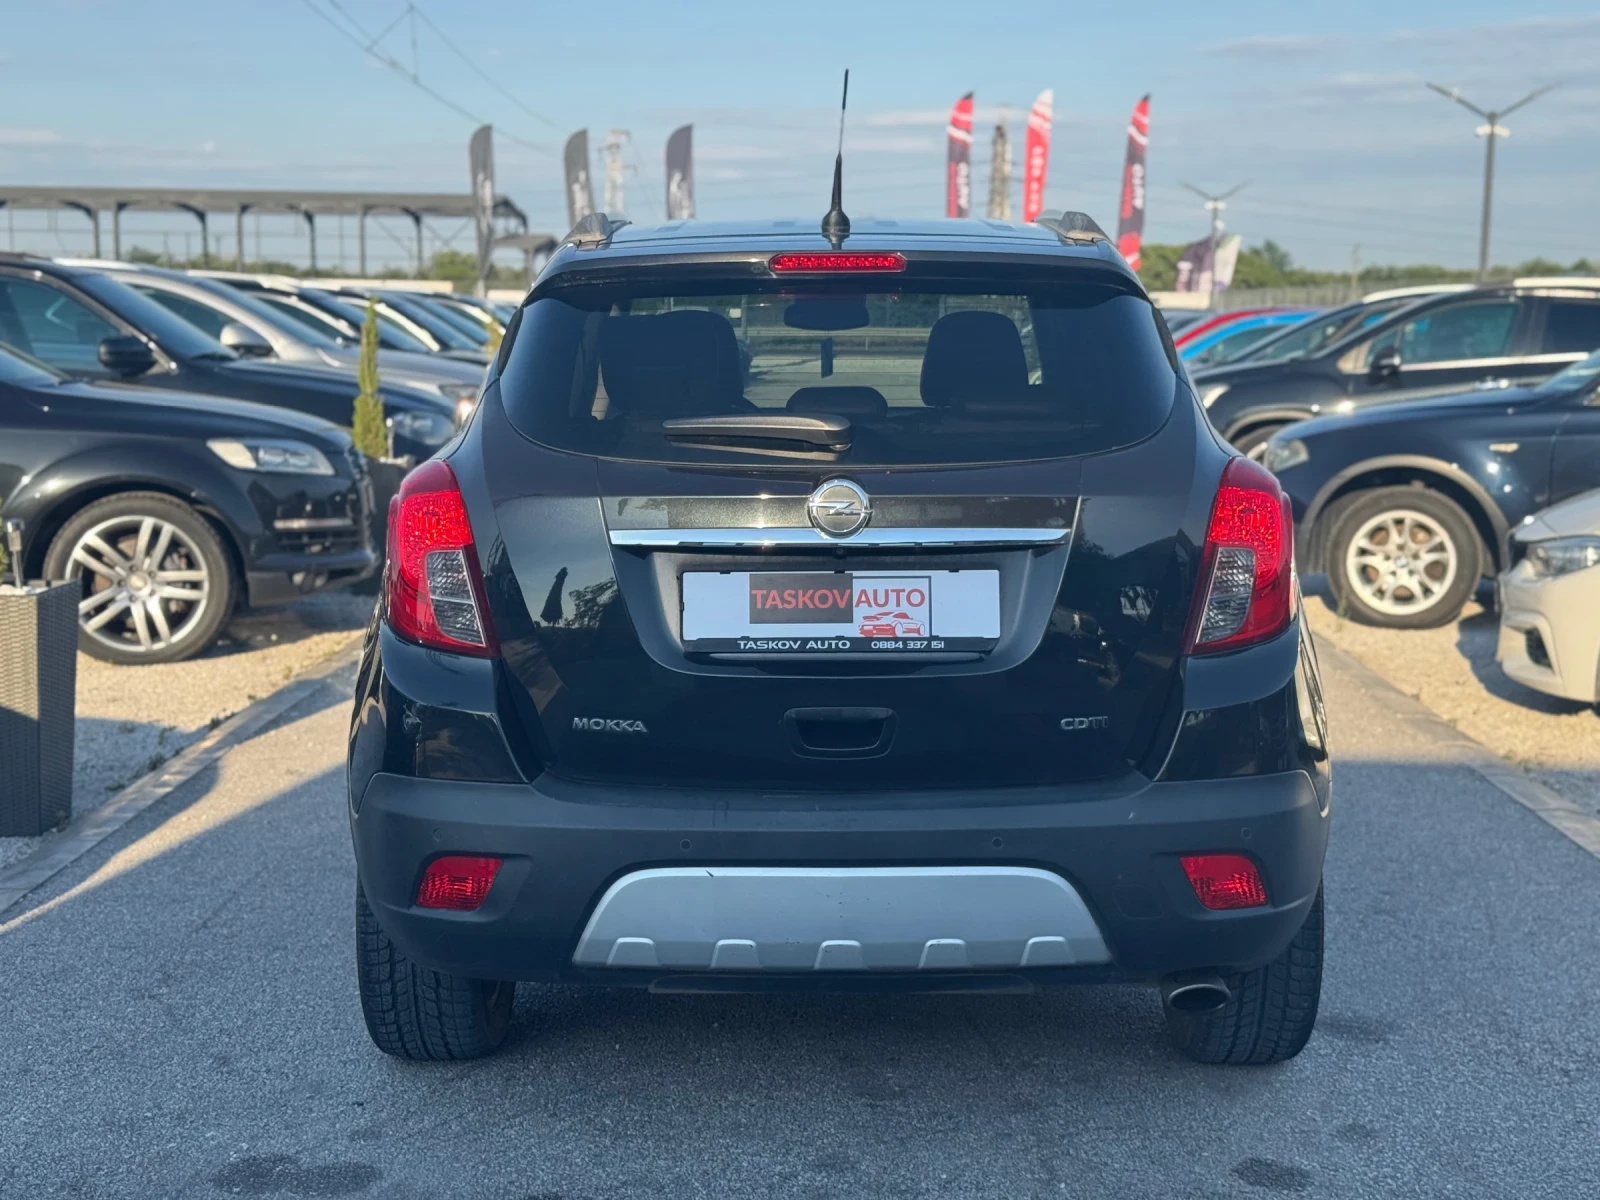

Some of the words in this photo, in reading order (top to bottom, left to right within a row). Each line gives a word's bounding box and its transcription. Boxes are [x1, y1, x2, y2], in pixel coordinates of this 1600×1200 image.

[751, 588, 851, 609] TASKOV
[854, 588, 926, 608] AUTO
[737, 640, 802, 650] TASKOV
[806, 640, 851, 649] AUTO
[871, 640, 904, 649] 0884
[906, 640, 928, 649] 337
[572, 717, 649, 733] MOKKA
[1060, 715, 1109, 730] CDTI
